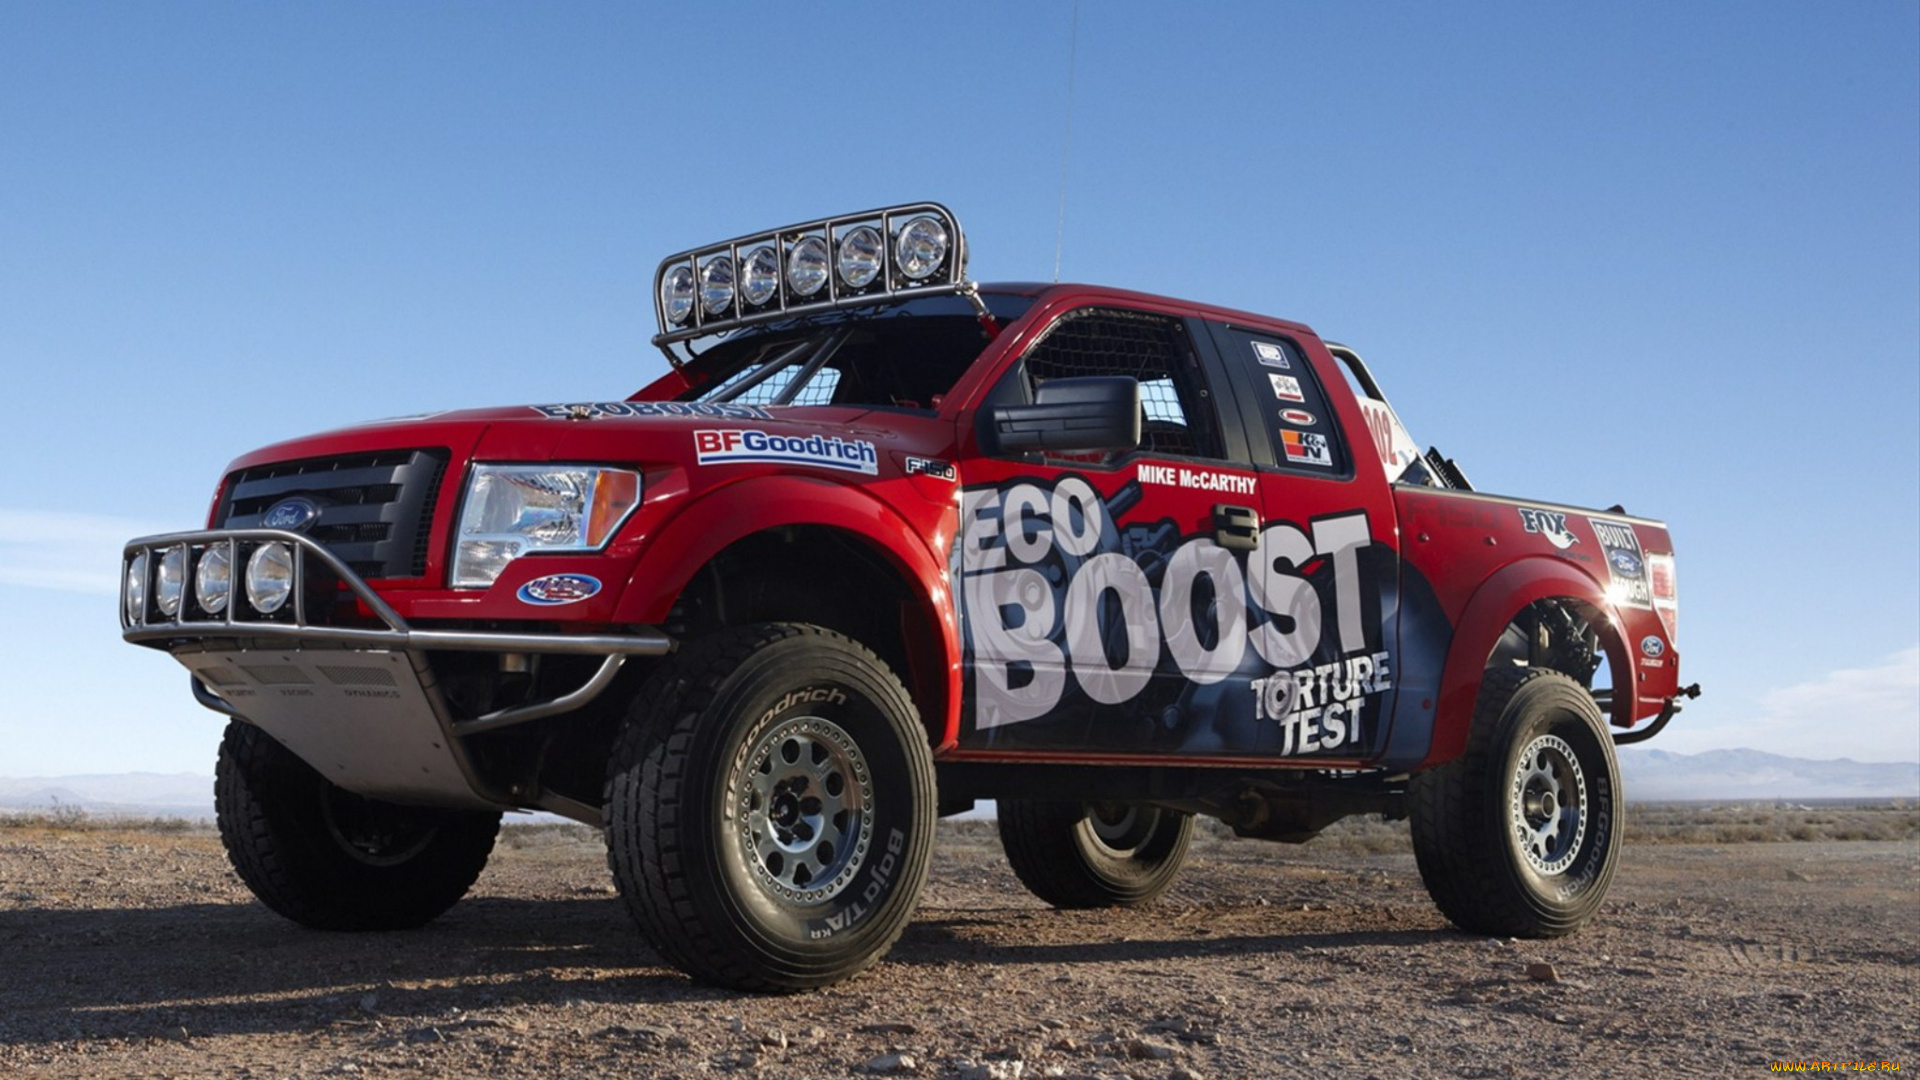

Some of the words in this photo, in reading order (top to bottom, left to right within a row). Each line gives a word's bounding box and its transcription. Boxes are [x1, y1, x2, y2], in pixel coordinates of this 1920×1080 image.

[535, 403, 772, 419] ECOBOOST
[700, 431, 876, 463] BFGoodrich
[907, 457, 955, 481] F-150
[1138, 464, 1176, 486] MIKE
[1179, 469, 1256, 495] McCARTHY
[271, 505, 300, 527] Ford
[964, 477, 1101, 572] ECO
[1518, 508, 1567, 536] FOX
[1595, 523, 1637, 551] BUILT
[963, 514, 1372, 731] BOOST
[1250, 651, 1392, 720] TORTURE
[1279, 697, 1366, 756] TEST
[863, 827, 904, 903] Baja
